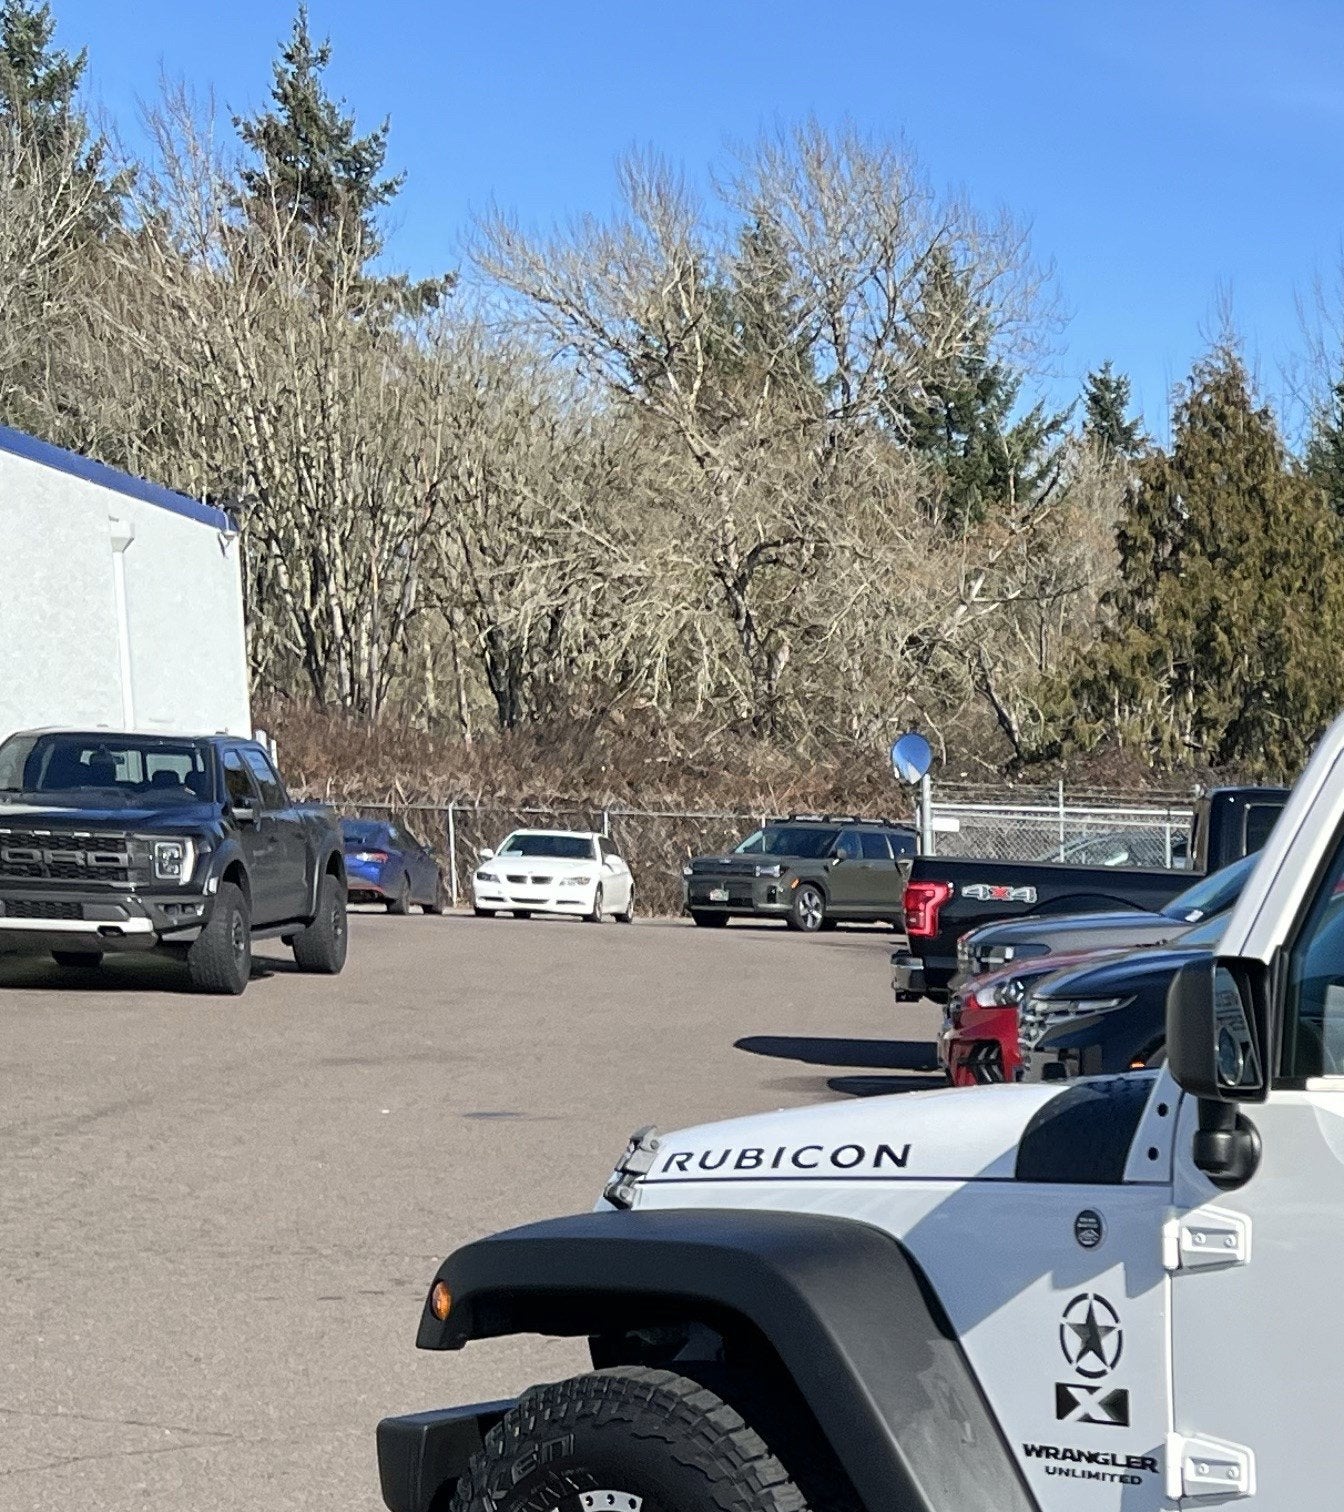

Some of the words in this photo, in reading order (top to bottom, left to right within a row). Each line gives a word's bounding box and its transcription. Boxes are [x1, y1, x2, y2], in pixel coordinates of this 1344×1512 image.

[661, 1143, 913, 1174] RUBICON
[1022, 1443, 1160, 1474] WRANGLER
[1044, 1465, 1143, 1486] UNLIMITED
